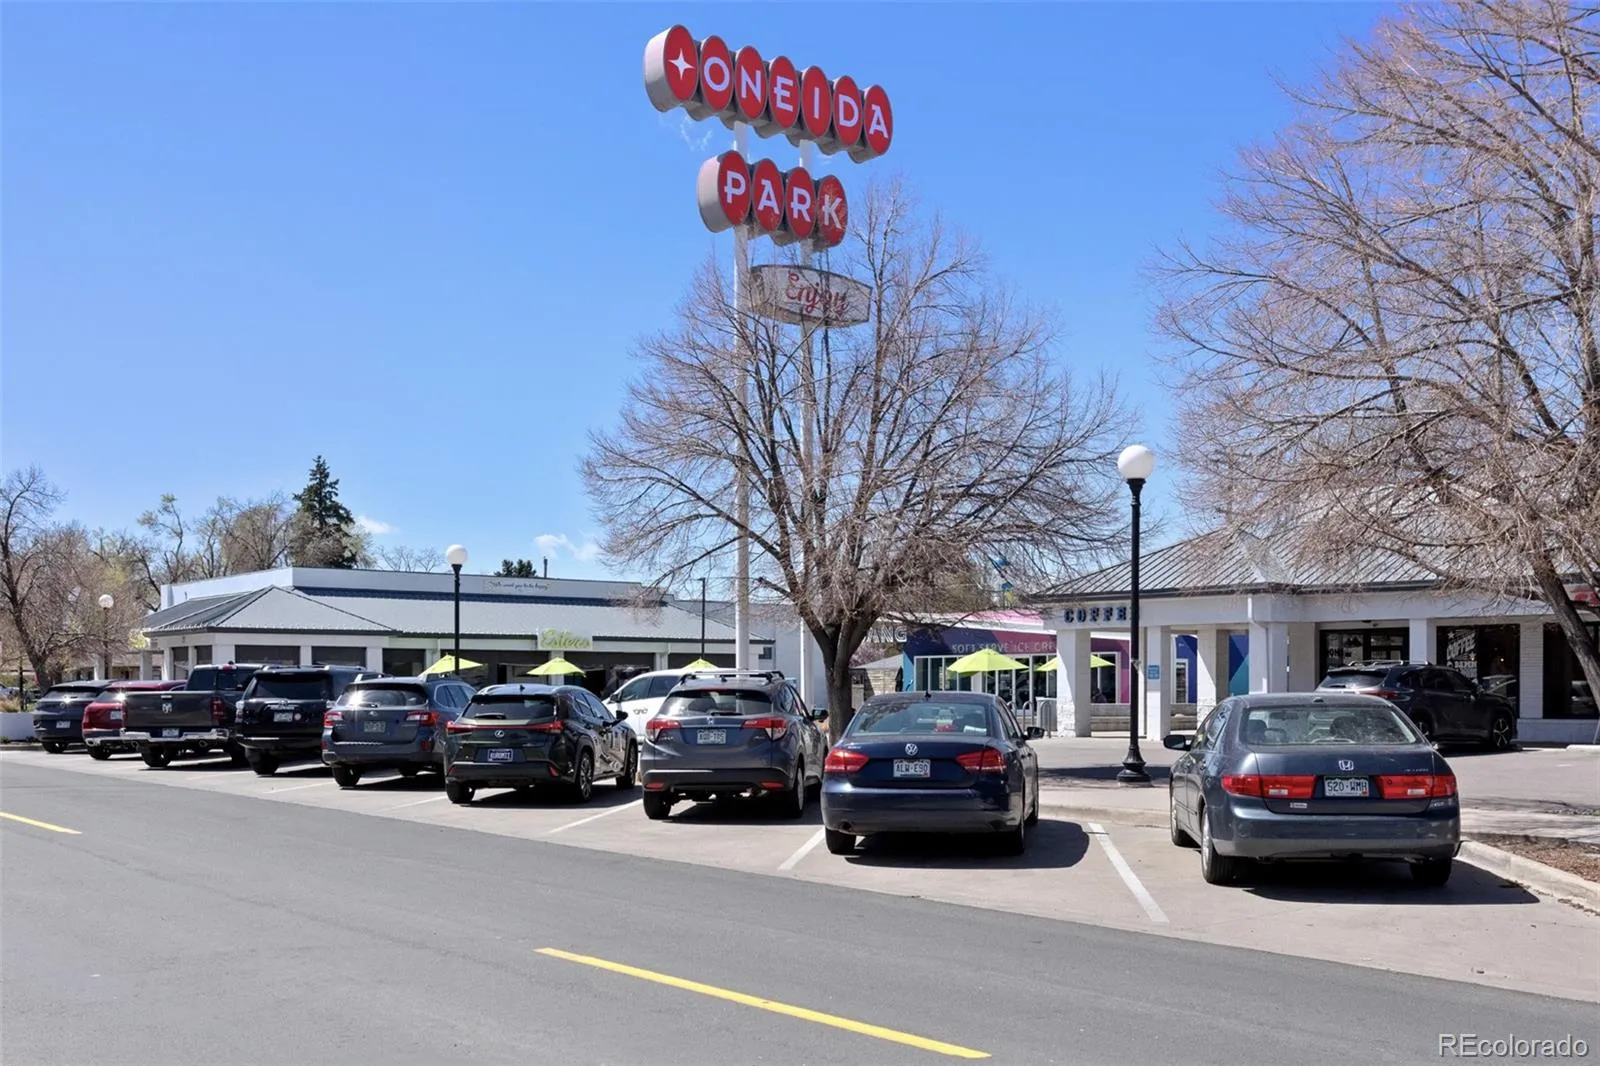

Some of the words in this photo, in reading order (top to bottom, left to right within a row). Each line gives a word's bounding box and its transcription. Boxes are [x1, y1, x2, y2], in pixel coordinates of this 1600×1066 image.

[704, 56, 889, 139] ONEIDA
[724, 170, 843, 229] PARK
[786, 272, 849, 318] Enjoy
